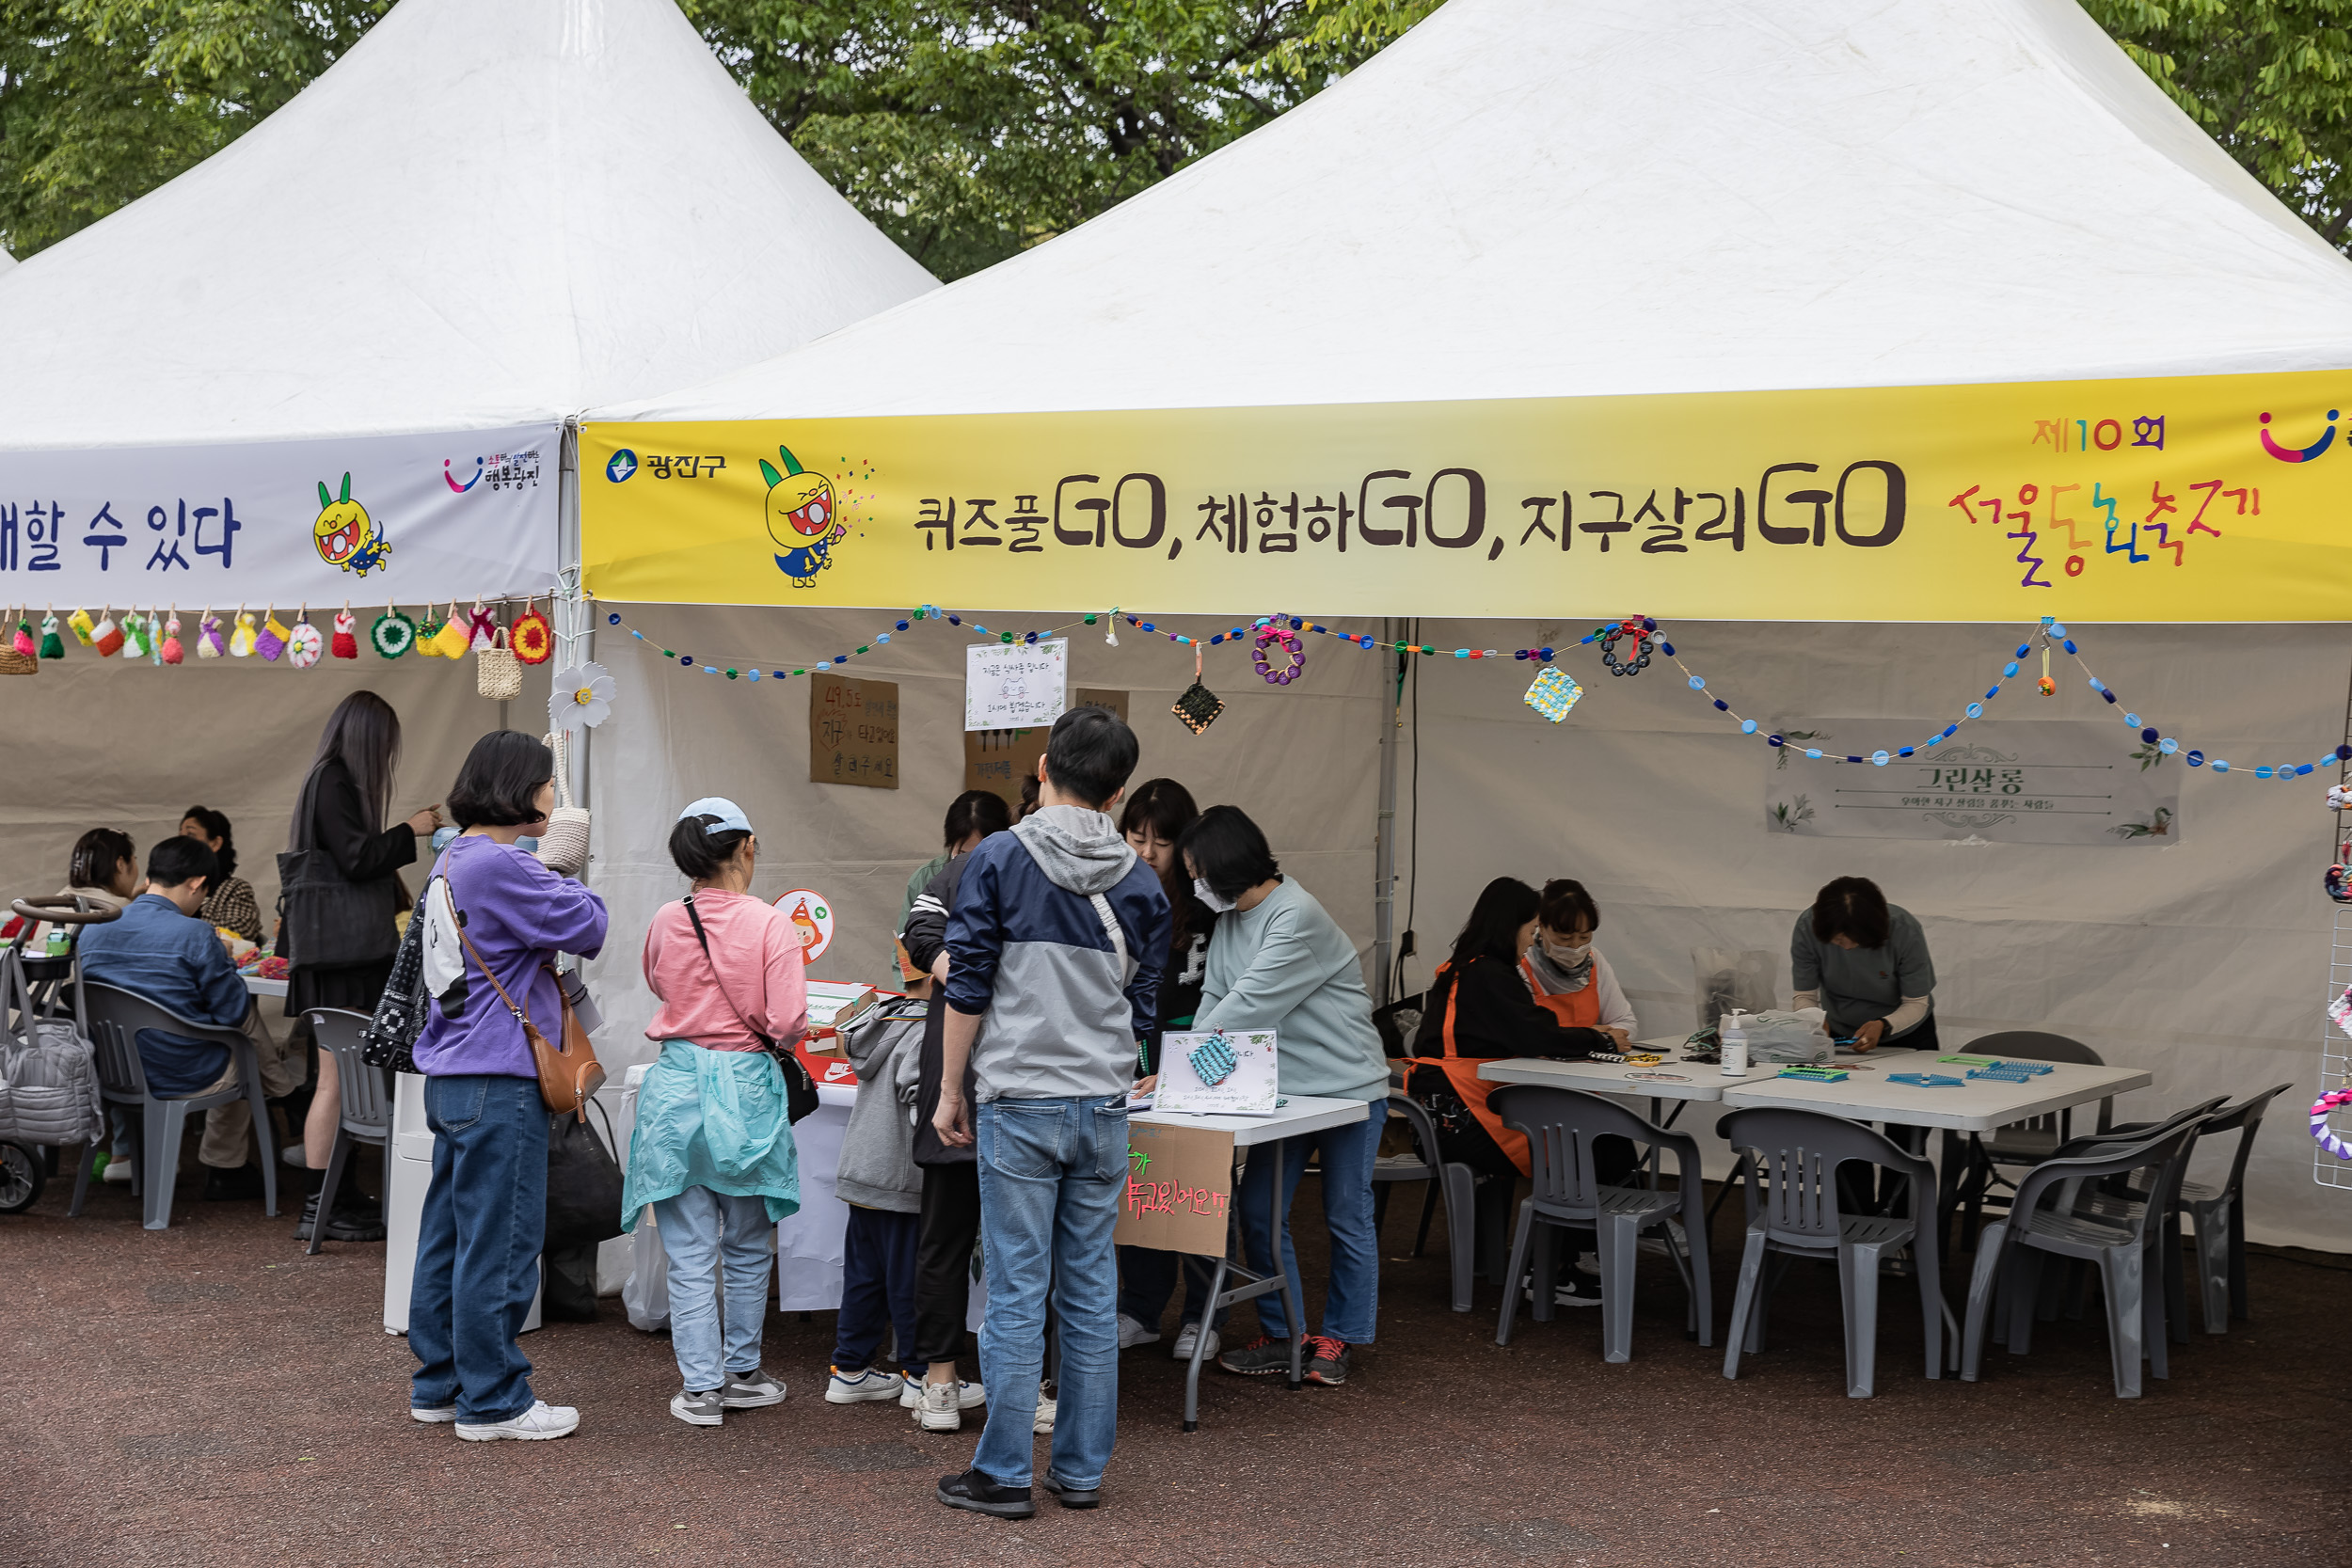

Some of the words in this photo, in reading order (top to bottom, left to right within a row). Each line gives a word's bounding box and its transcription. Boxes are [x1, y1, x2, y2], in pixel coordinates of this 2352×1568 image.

[2032, 415, 2165, 453] 제10회
[485, 465, 540, 491] 행복광진
[645, 453, 727, 480] 광진구
[913, 471, 1181, 561] 퀴즈풀GO,
[1196, 467, 1504, 562] 체험하GO,
[1519, 459, 1907, 554] 지구살리GO
[83, 500, 128, 571] 수
[146, 497, 241, 571] 있다
[1916, 768, 2025, 795] 그린살롱
[829, 1062, 851, 1074] NIKE
